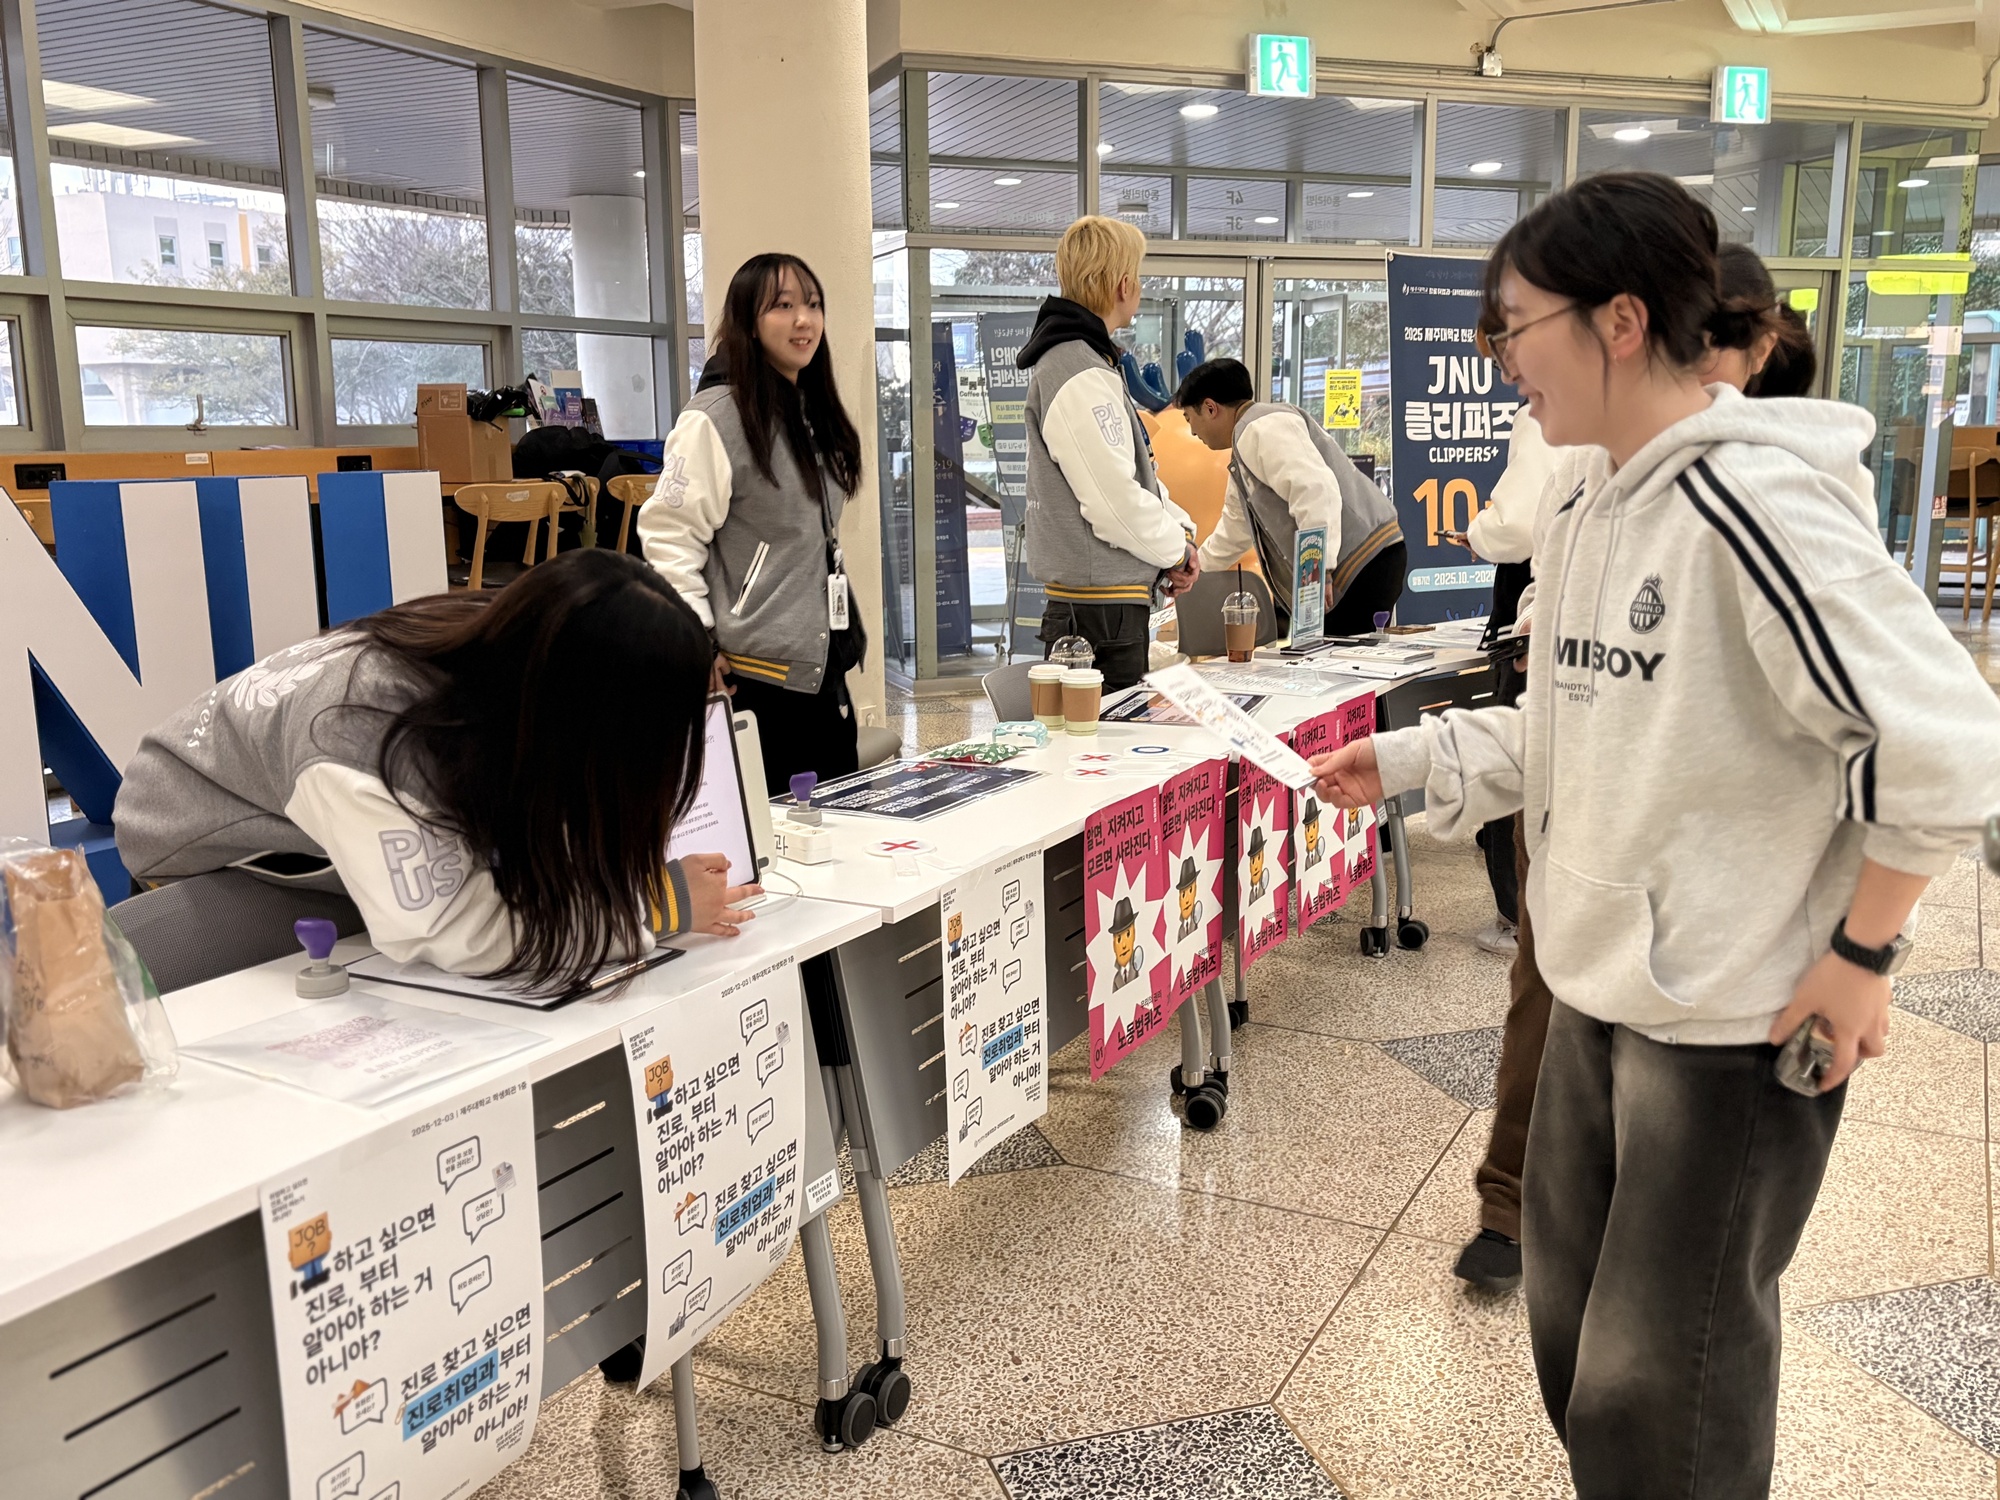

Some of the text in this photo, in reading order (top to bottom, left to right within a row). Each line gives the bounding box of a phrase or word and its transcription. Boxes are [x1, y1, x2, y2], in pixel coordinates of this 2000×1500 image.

[1404, 326, 1423, 341] 2025
[1424, 327, 1460, 342] 제주대학교
[1427, 356, 1492, 394] JNU
[1405, 401, 1520, 441] 클리퍼즈
[1429, 446, 1499, 463] CLIPPERS+
[1300, 724, 1326, 749] 지켜지고
[1346, 704, 1366, 727] 지켜지고
[1163, 788, 1177, 816] 알면,
[1179, 772, 1209, 802] 지켜지고
[1087, 822, 1106, 852] 알면,
[1108, 805, 1144, 838] 지켜지고
[1163, 811, 1181, 841] 모르면
[1183, 794, 1216, 825] 사라진다
[1087, 846, 1113, 880] 모르면
[1115, 828, 1151, 863] 사라진다
[949, 915, 961, 931] JOB
[1308, 885, 1340, 918] 노동법퀴즈
[953, 930, 957, 938] ?
[961, 932, 977, 953] 하고
[978, 918, 1001, 942] 싶으면
[1250, 919, 1283, 956] 노동법퀴즈
[721, 979, 749, 999] 2025-12-03
[752, 967, 771, 982] 제주대학교
[771, 959, 788, 971] 학생회관
[950, 976, 972, 1003] 알아야
[973, 967, 988, 986] 하는
[989, 958, 997, 975] 거
[951, 946, 985, 982] 진로, 부터
[1179, 954, 1216, 996] 노동법퀴즈
[950, 992, 976, 1020] 아니야?
[981, 1021, 997, 1044] 진로
[998, 1010, 1013, 1032] 찾고
[1015, 997, 1040, 1023] 싶으면
[1117, 1005, 1162, 1051] 노동법퀴즈
[983, 1028, 1022, 1065] 진로취업과
[1024, 1018, 1040, 1040] 부터
[989, 1039, 1040, 1084] 알아야 하는 거
[649, 1060, 669, 1082] JOB
[657, 1078, 663, 1090] ?
[674, 1053, 740, 1105] 하고 싶으면
[1012, 1062, 1041, 1088] 아니야!
[411, 1081, 527, 1137] 2025-12-03 제주대학교 학생회관 1층
[657, 1092, 716, 1146] 진로, 부터
[655, 1104, 737, 1173] 알아야 하는 거
[657, 1152, 705, 1194] 아니야?
[715, 1183, 738, 1213] 진로
[741, 1165, 763, 1195] 찾고
[765, 1138, 797, 1177] 싶으면
[718, 1164, 796, 1238] 진로취업과 부터
[294, 1219, 326, 1248] JOB
[333, 1203, 436, 1273] 하고 싶으면
[725, 1217, 758, 1258] 알아야
[761, 1203, 781, 1227] 하는
[784, 1189, 795, 1210] 거
[757, 1215, 792, 1253] 아니야!
[307, 1242, 316, 1256] ?
[305, 1253, 399, 1325] 진로, 부터
[302, 1265, 433, 1361] 알아야 하는 거
[305, 1329, 381, 1386] 아니야?
[401, 1361, 438, 1401] 진로
[442, 1337, 478, 1377] 찾고
[482, 1302, 531, 1352] 싶으면
[407, 1332, 531, 1432] 진로취업과 부터
[420, 1362, 530, 1456] 알아야 하는 거
[473, 1394, 529, 1443] 아니야!
